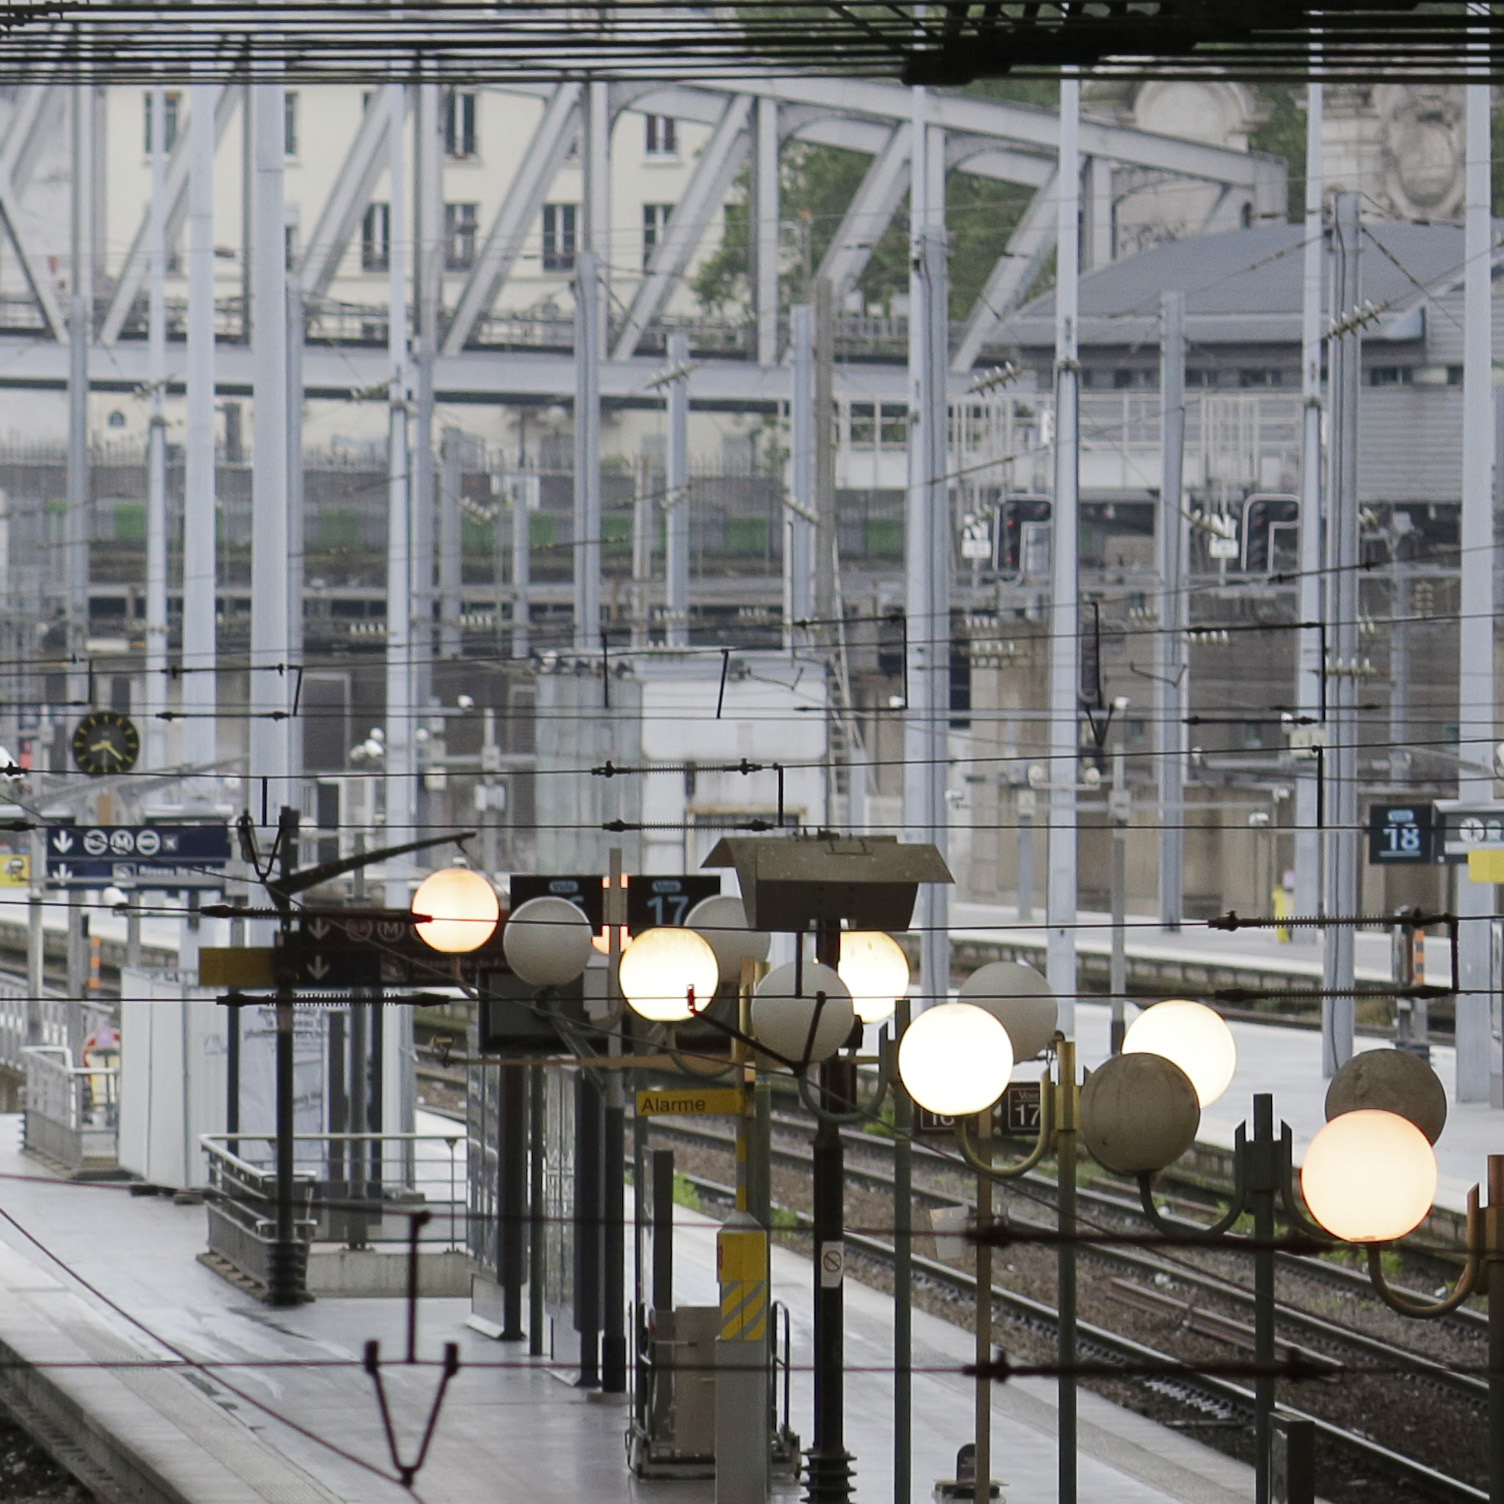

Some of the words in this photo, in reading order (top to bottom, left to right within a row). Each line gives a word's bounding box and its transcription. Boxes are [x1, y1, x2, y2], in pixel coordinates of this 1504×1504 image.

[1383, 823, 1421, 851] 18
[647, 896, 689, 925] 17
[642, 1098, 706, 1113] Alarme
[1015, 1104, 1040, 1126] 17
